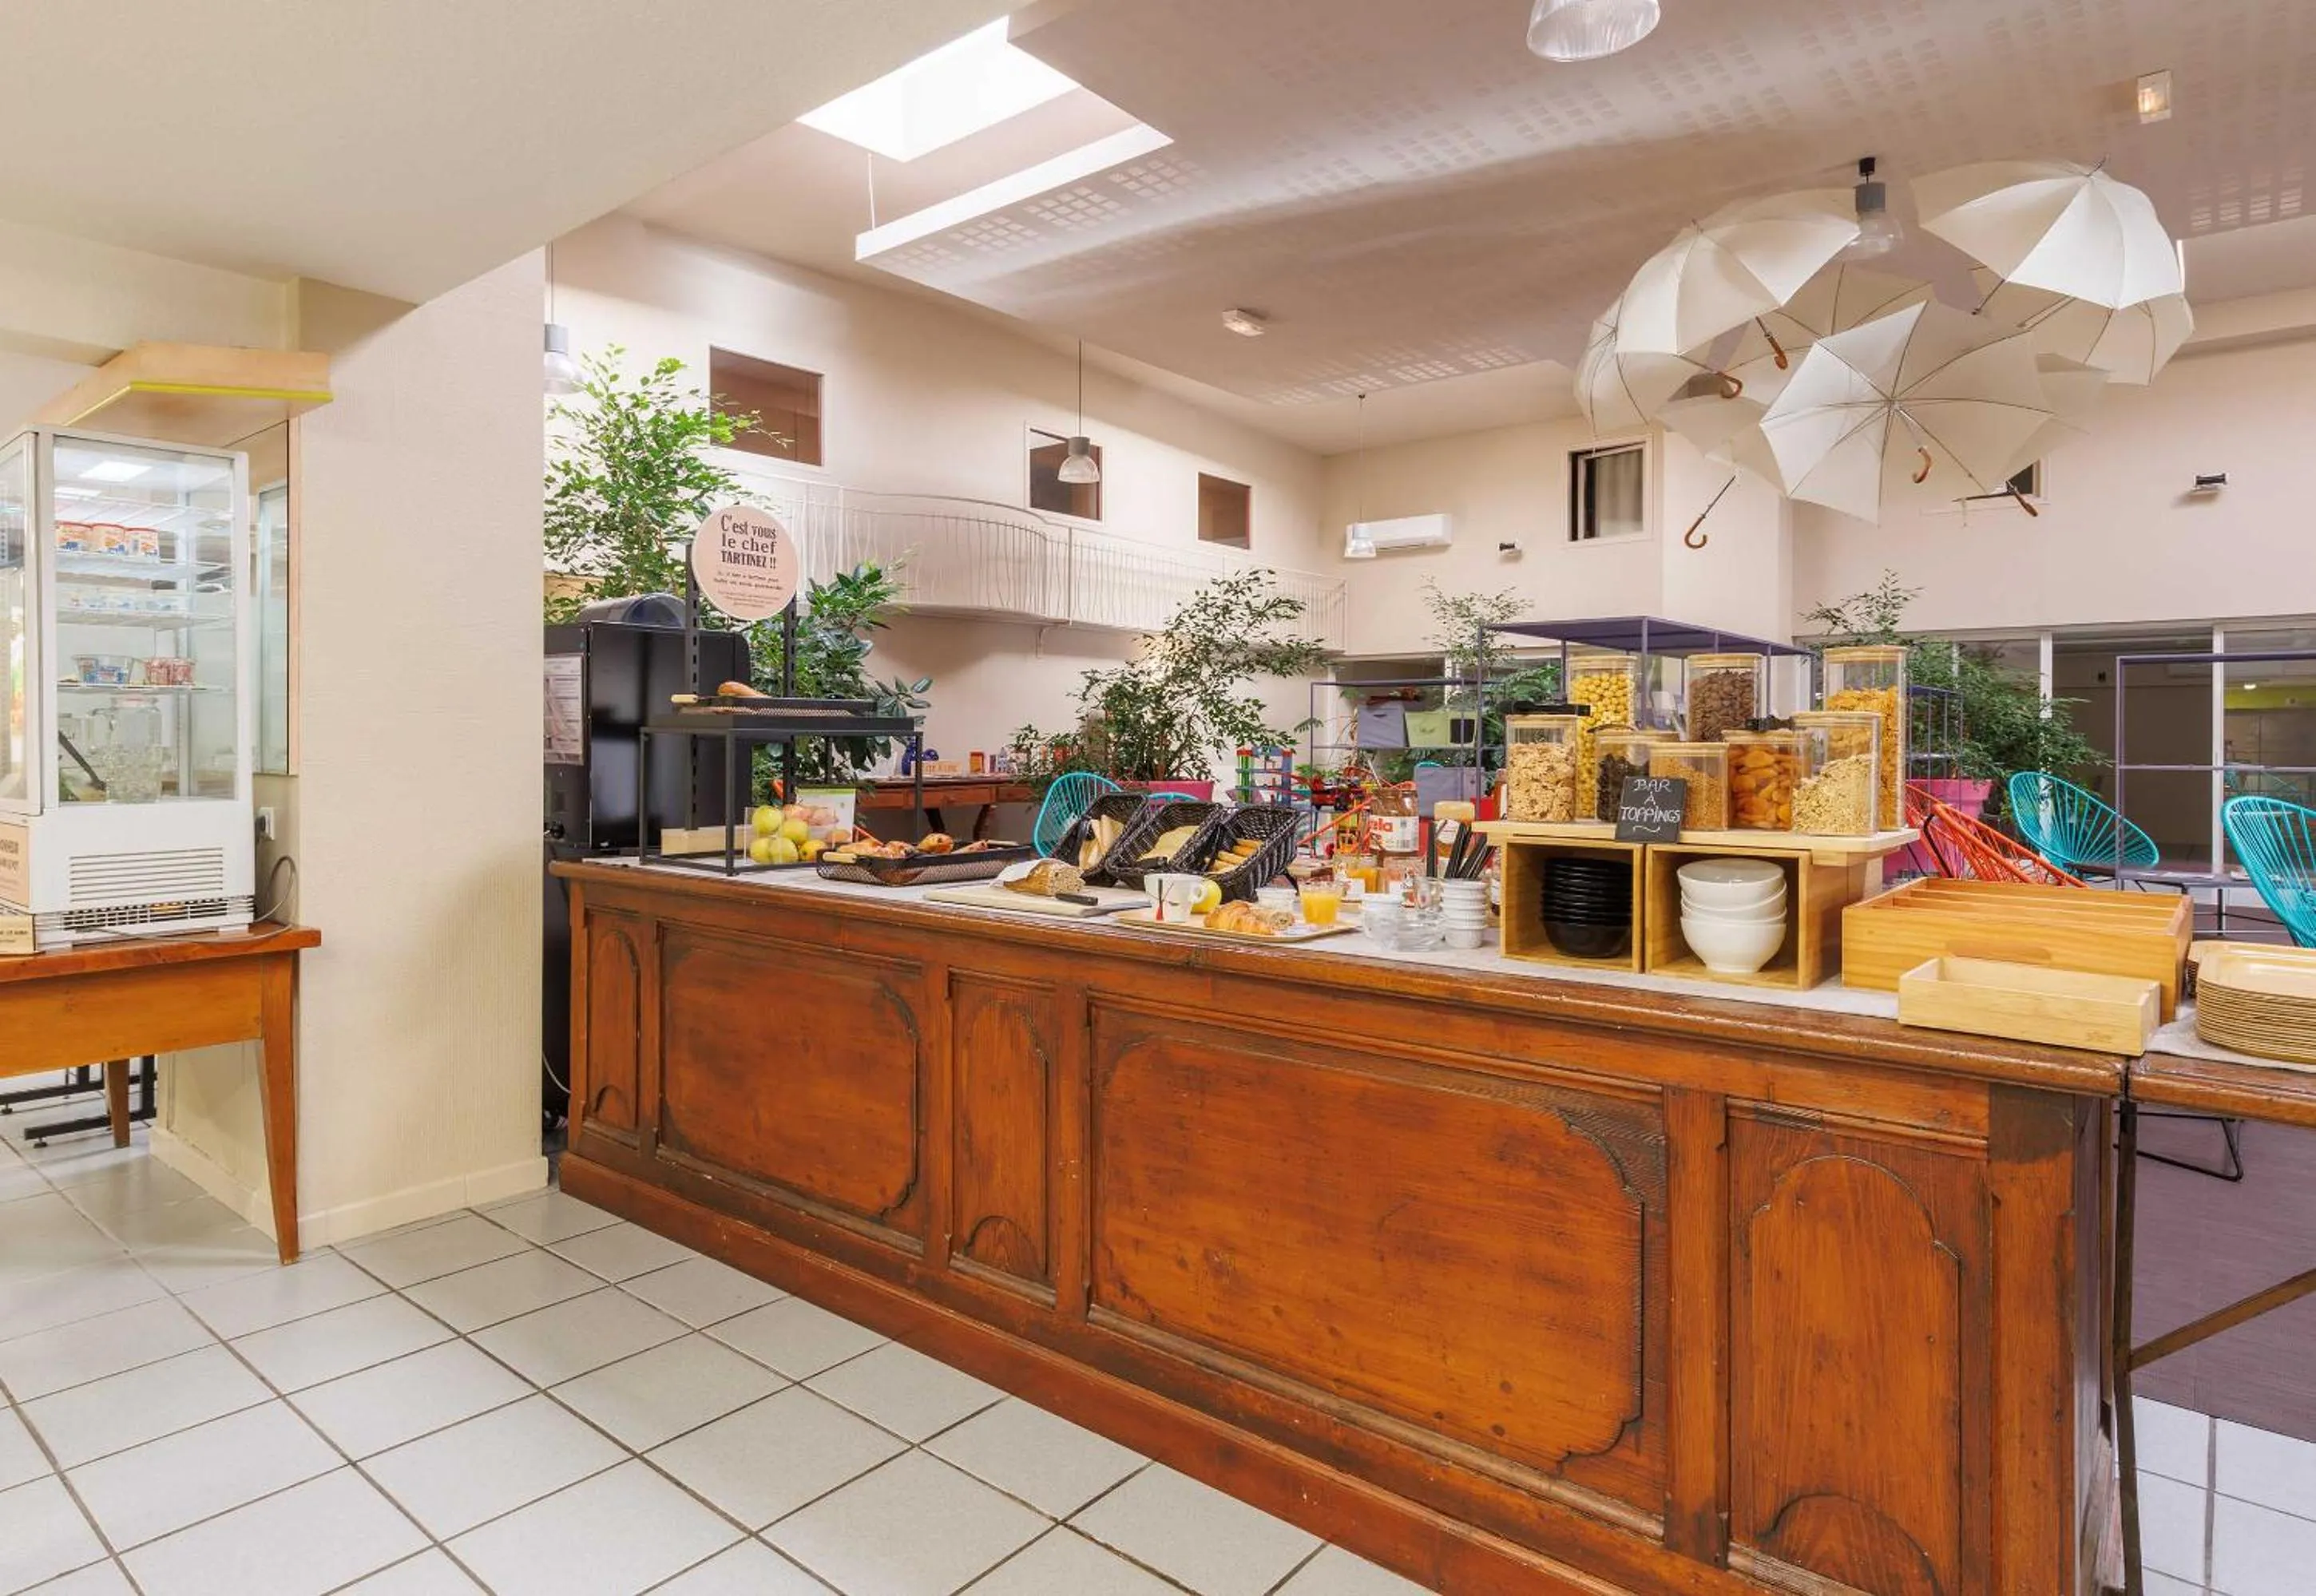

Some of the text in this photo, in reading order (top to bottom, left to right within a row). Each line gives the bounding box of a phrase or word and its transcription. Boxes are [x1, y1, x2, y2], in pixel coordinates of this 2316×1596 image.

[721, 513, 748, 535] C'est
[722, 533, 777, 554] le chef
[721, 550, 767, 568] TARTINEZ
[1633, 778, 1672, 792] BAR
[1620, 805, 1680, 823] TOPPINGS
